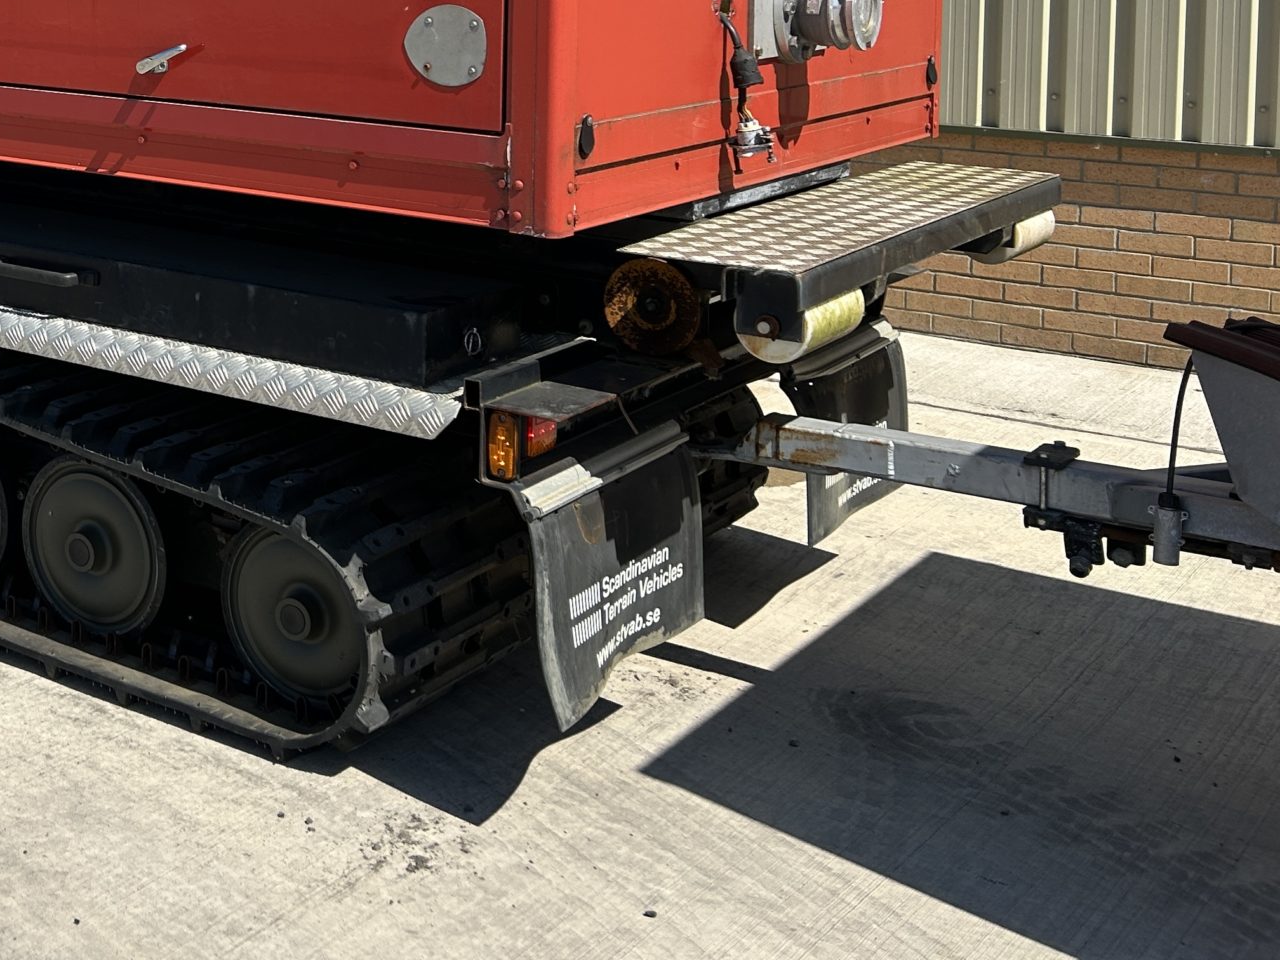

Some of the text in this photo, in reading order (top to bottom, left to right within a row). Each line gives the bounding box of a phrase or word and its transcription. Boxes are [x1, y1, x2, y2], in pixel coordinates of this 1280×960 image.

[837, 476, 882, 509] www.stvab.
[601, 546, 670, 599] Scandinavian
[603, 562, 684, 625] Terrain Vehicles
[596, 607, 661, 669] www.stvab.se
